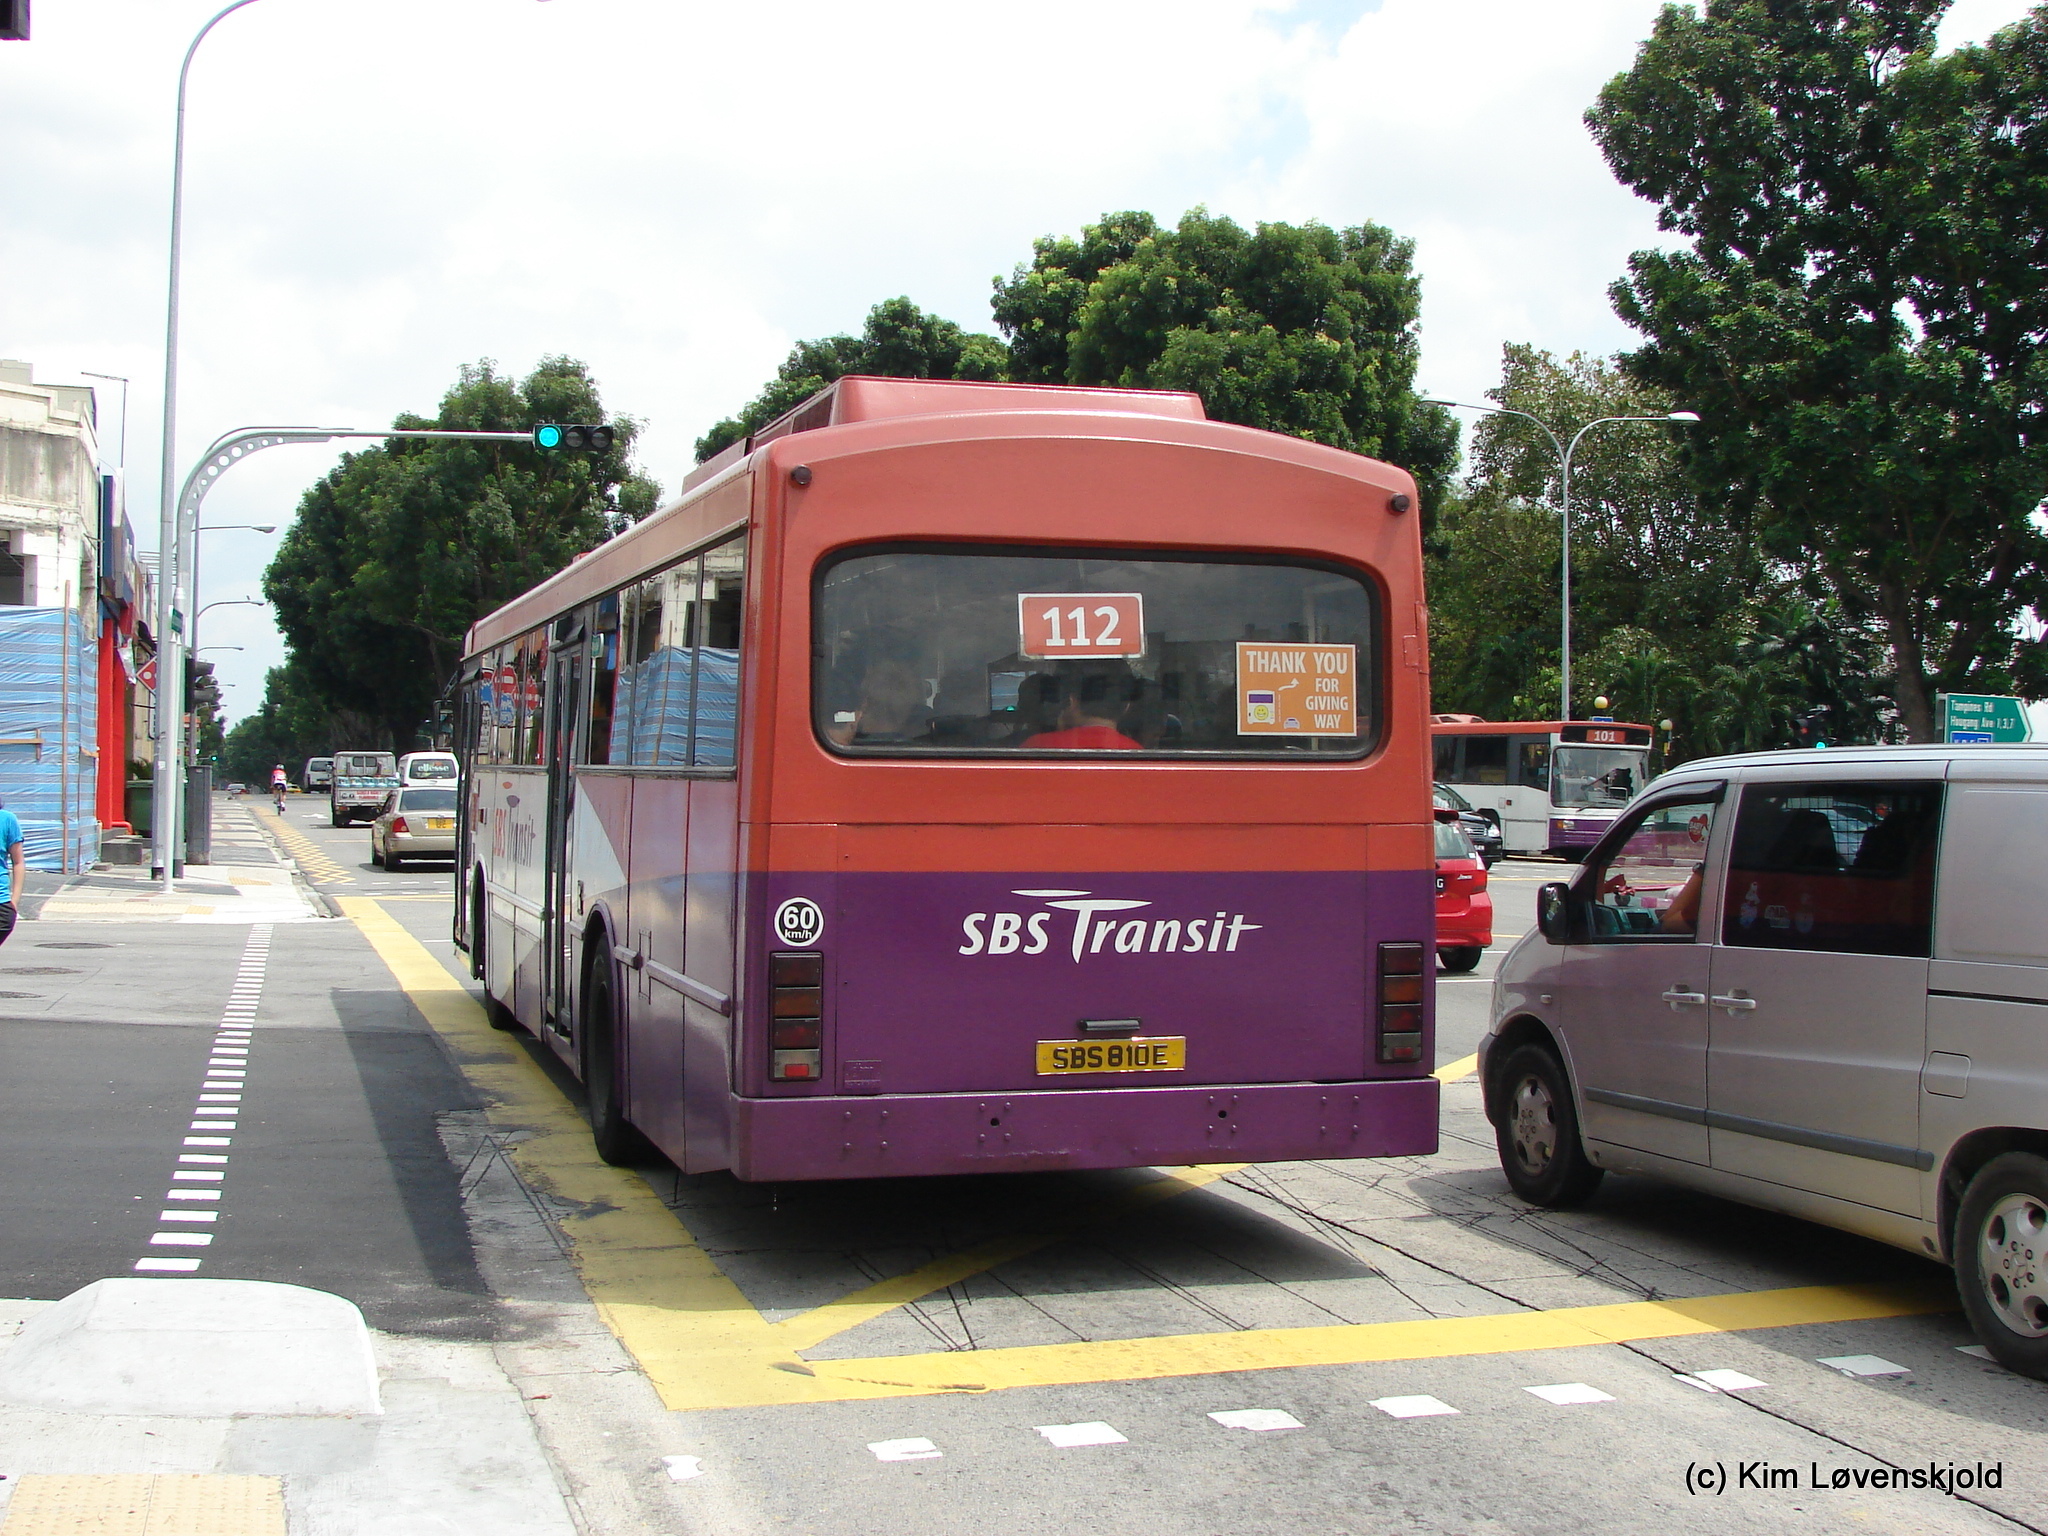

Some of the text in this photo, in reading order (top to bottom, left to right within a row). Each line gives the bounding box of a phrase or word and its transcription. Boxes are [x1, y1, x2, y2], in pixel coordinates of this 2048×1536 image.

[1042, 606, 1122, 646] 112
[1246, 651, 1348, 674] THANK YOU
[1315, 678, 1339, 693] FOR
[1305, 696, 1348, 711] GIVING
[1983, 701, 1994, 713] Rd
[1314, 714, 1341, 729] WAY
[1950, 715, 1979, 730] Hougang
[1981, 717, 1995, 728] Ave
[1594, 730, 1615, 742] 101
[783, 906, 816, 929] 60
[784, 929, 813, 939] km/h
[958, 899, 1263, 964] SBS Transit
